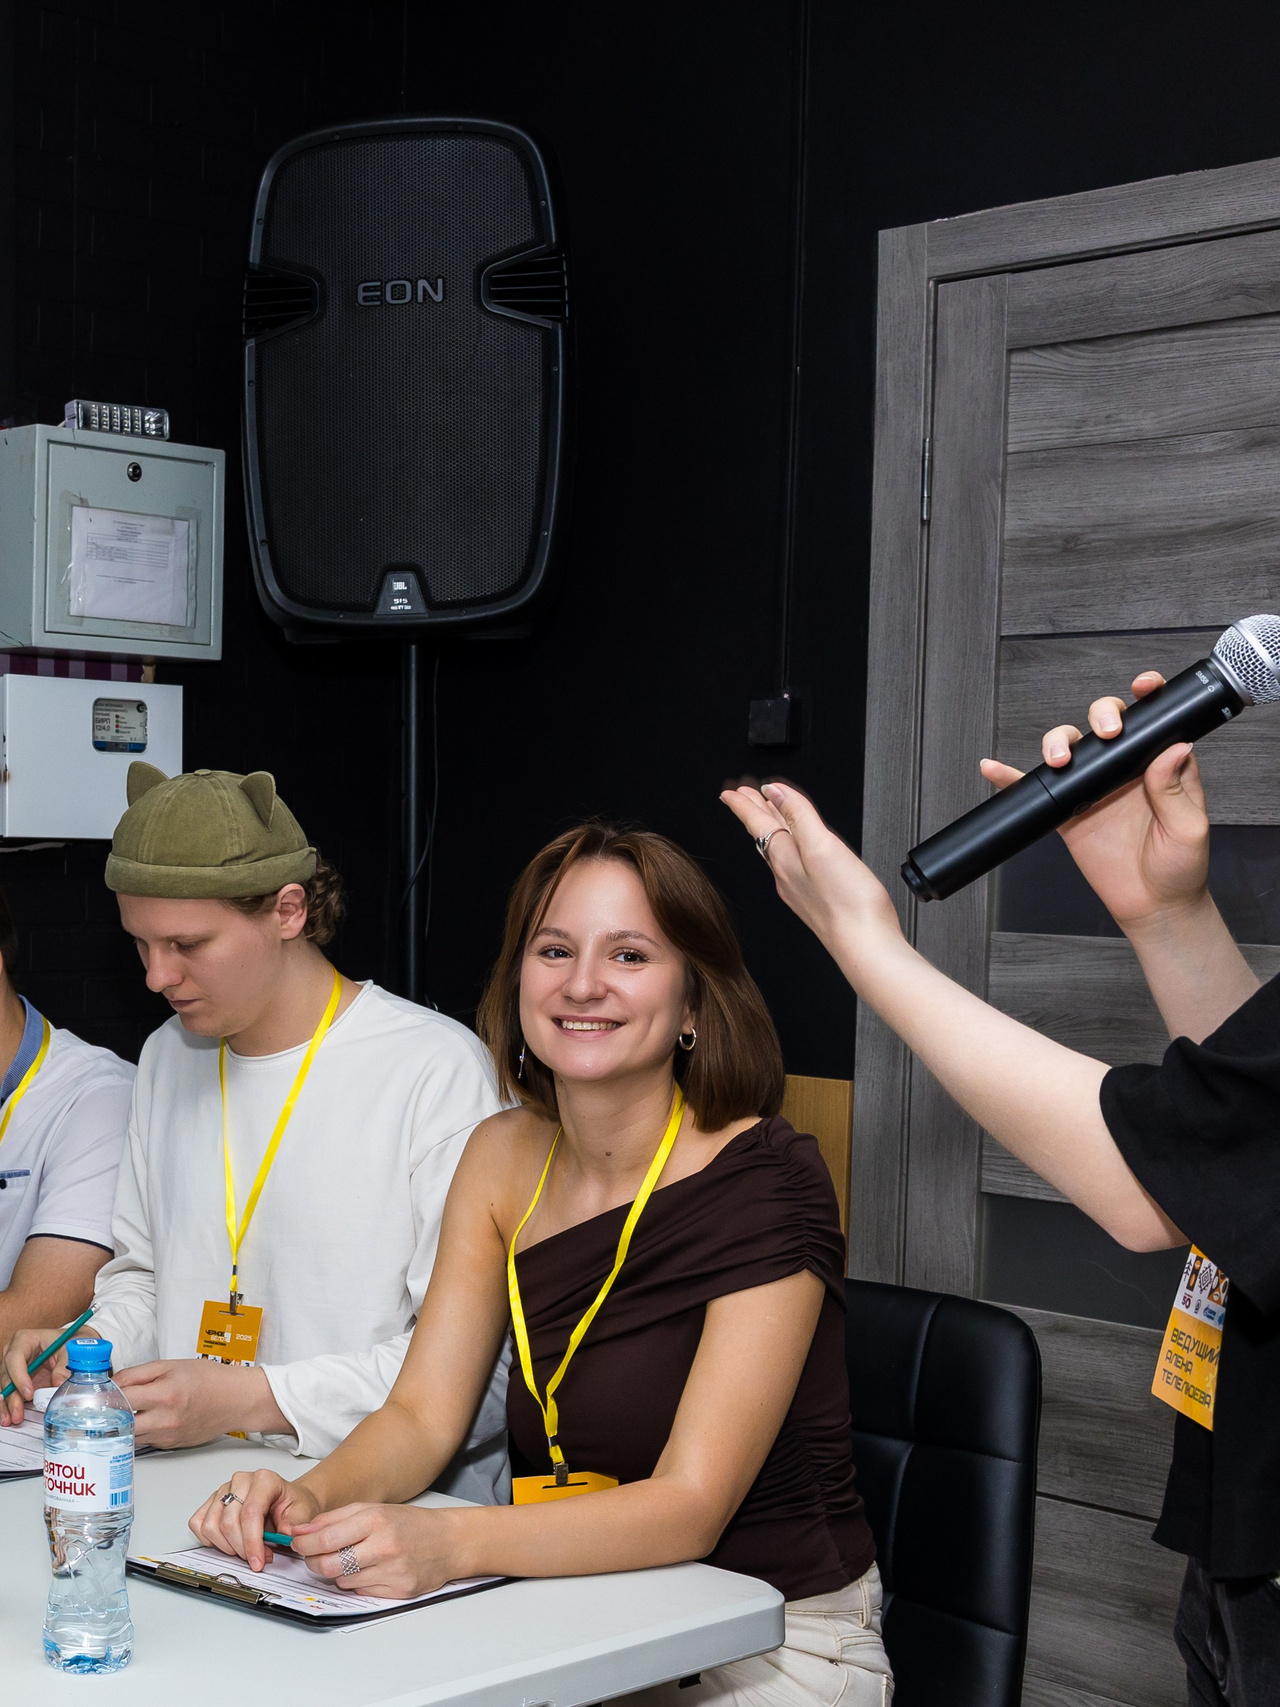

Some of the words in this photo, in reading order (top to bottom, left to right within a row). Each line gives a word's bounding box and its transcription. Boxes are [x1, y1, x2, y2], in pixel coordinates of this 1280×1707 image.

[357, 278, 443, 306] EON
[393, 581, 408, 590] JBL
[236, 1333, 252, 1341] 2025
[1170, 1327, 1220, 1366] ВЕДУЩИЙ
[44, 1459, 85, 1480] ВЯТОЙ
[44, 1476, 96, 1496] ТОЧНИК
